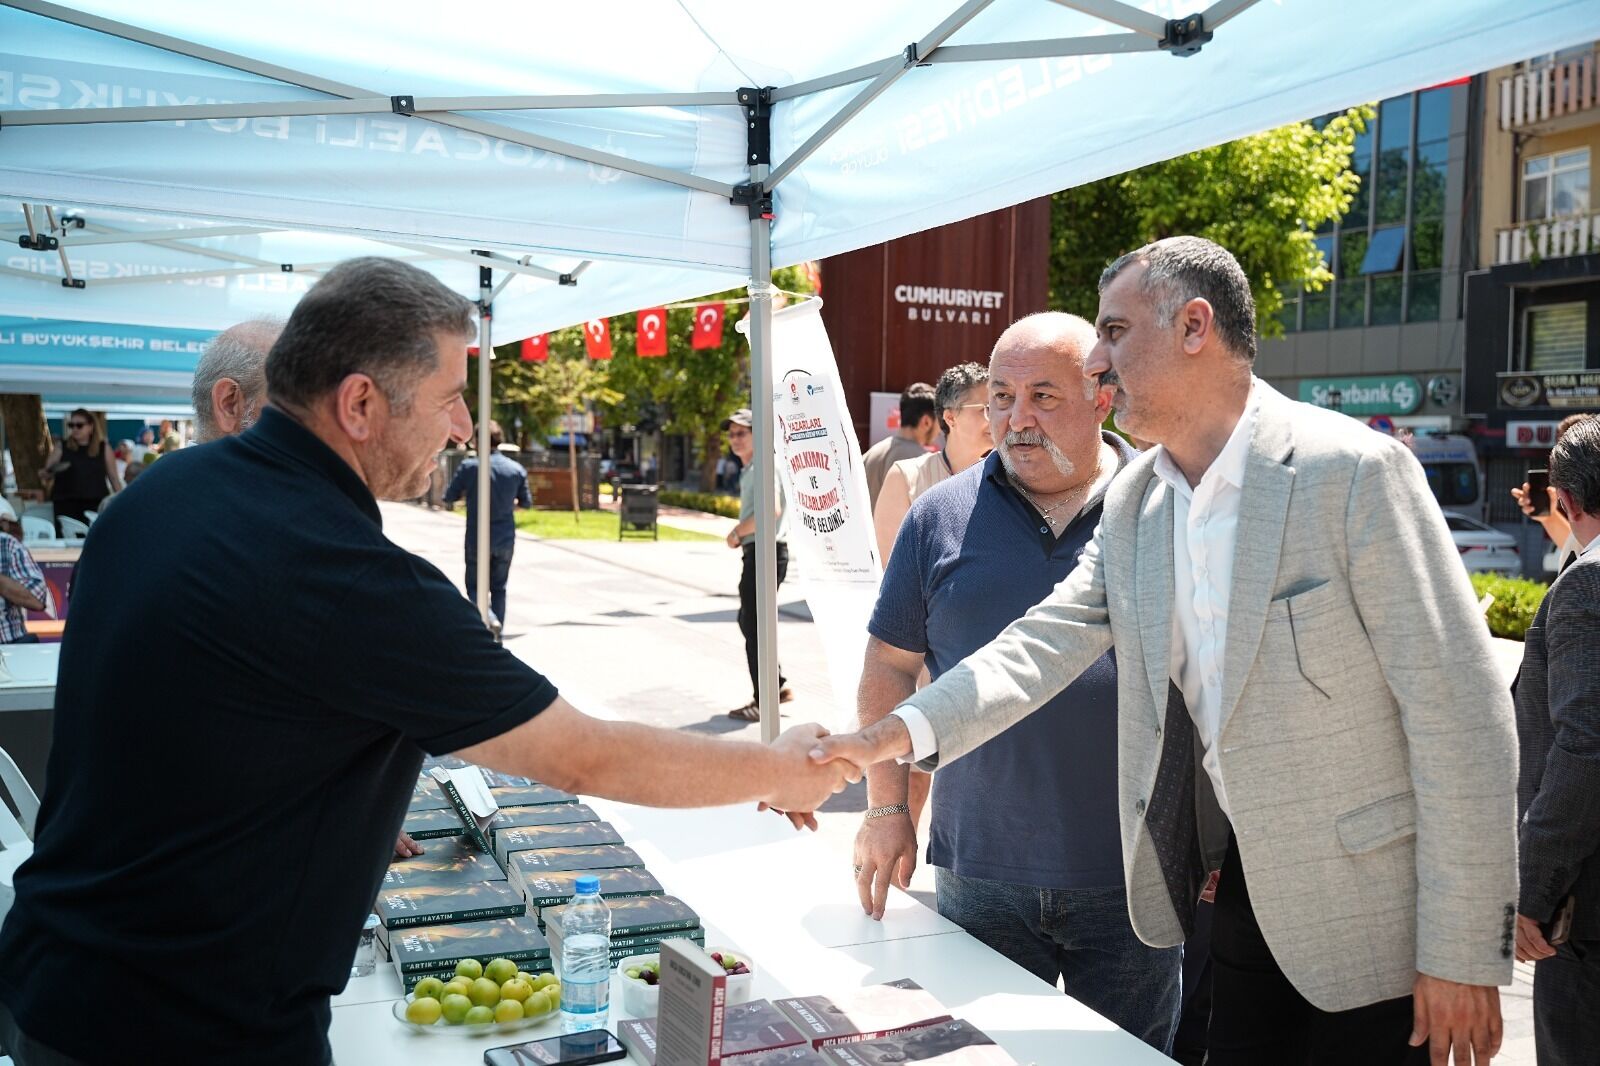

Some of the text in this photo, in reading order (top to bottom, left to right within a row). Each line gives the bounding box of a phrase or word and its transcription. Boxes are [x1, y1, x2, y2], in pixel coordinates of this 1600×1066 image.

[908, 308, 992, 326] BULVARI
[790, 450, 831, 473] HALKIMIZ
[809, 475, 819, 490] VE
[802, 508, 845, 536] HOŞ GELDİNİZ
[422, 913, 453, 922] HAYATIM
